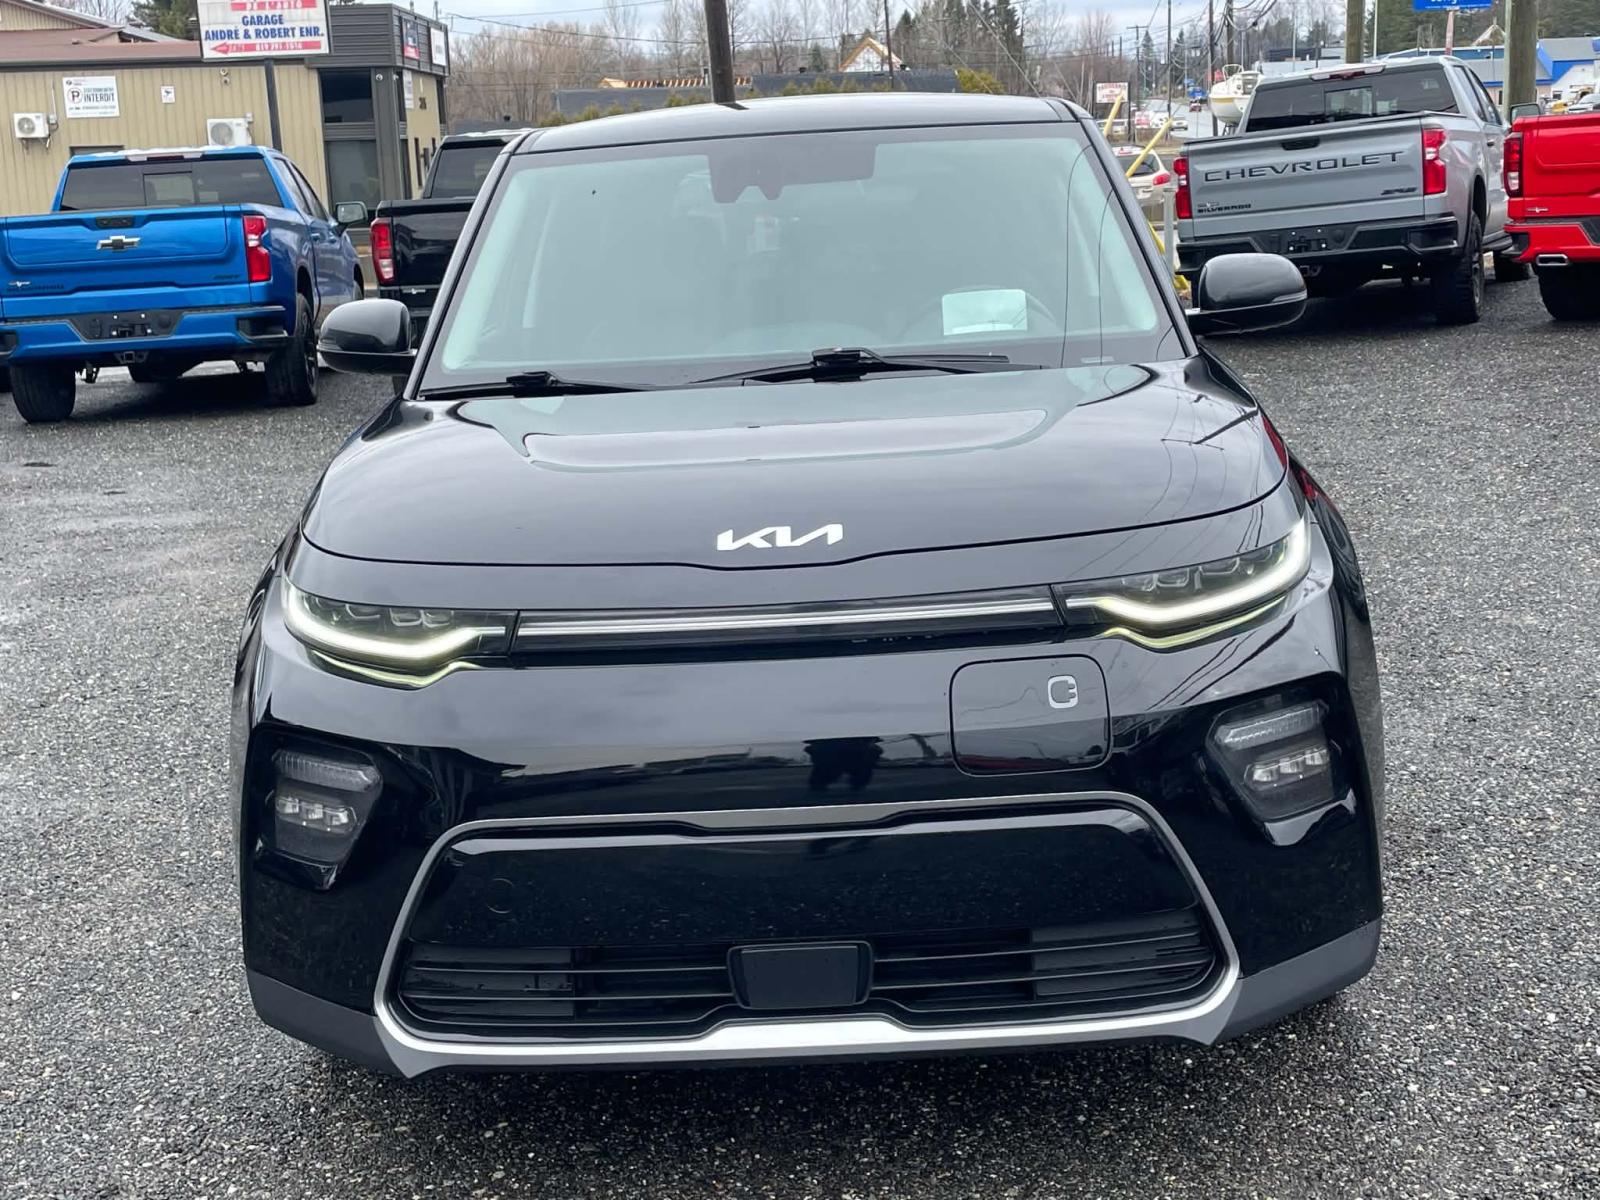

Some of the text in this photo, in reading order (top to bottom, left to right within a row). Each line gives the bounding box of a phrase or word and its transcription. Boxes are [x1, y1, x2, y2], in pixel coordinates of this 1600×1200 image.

[241, 14, 284, 26] GARAGE
[204, 26, 325, 41] ANDRÉ & ROBERT ENR.
[83, 92, 115, 103] INTERDIT
[1204, 150, 1405, 183] CHEVROLET
[716, 523, 843, 551] KIA
